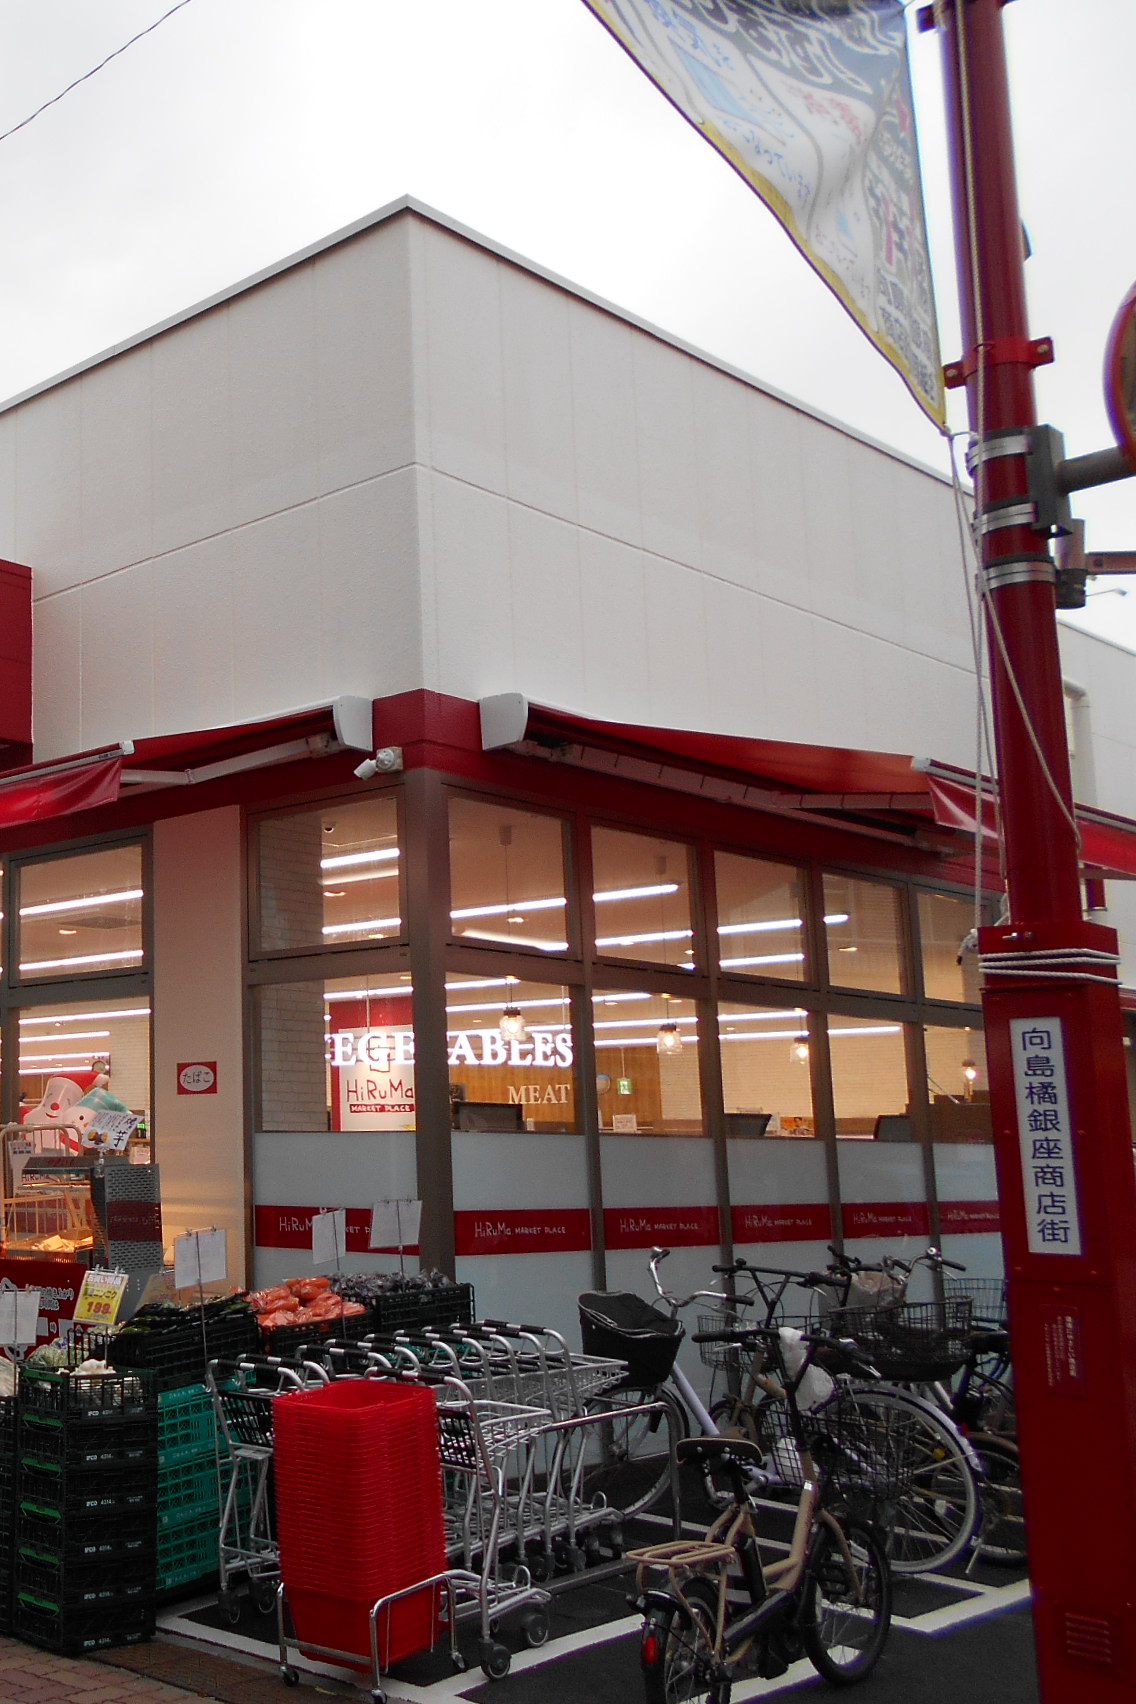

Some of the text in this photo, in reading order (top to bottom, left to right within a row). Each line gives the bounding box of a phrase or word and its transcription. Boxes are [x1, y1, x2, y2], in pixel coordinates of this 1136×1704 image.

[324, 1031, 573, 1067] EGEABLES
[182, 1070, 211, 1084] たばこ
[508, 1084, 570, 1105] MEAT
[1021, 1027, 1071, 1244] 向島橘銀座商店街
[279, 1216, 313, 1231] HiRuM
[544, 1226, 566, 1234] PLACE
